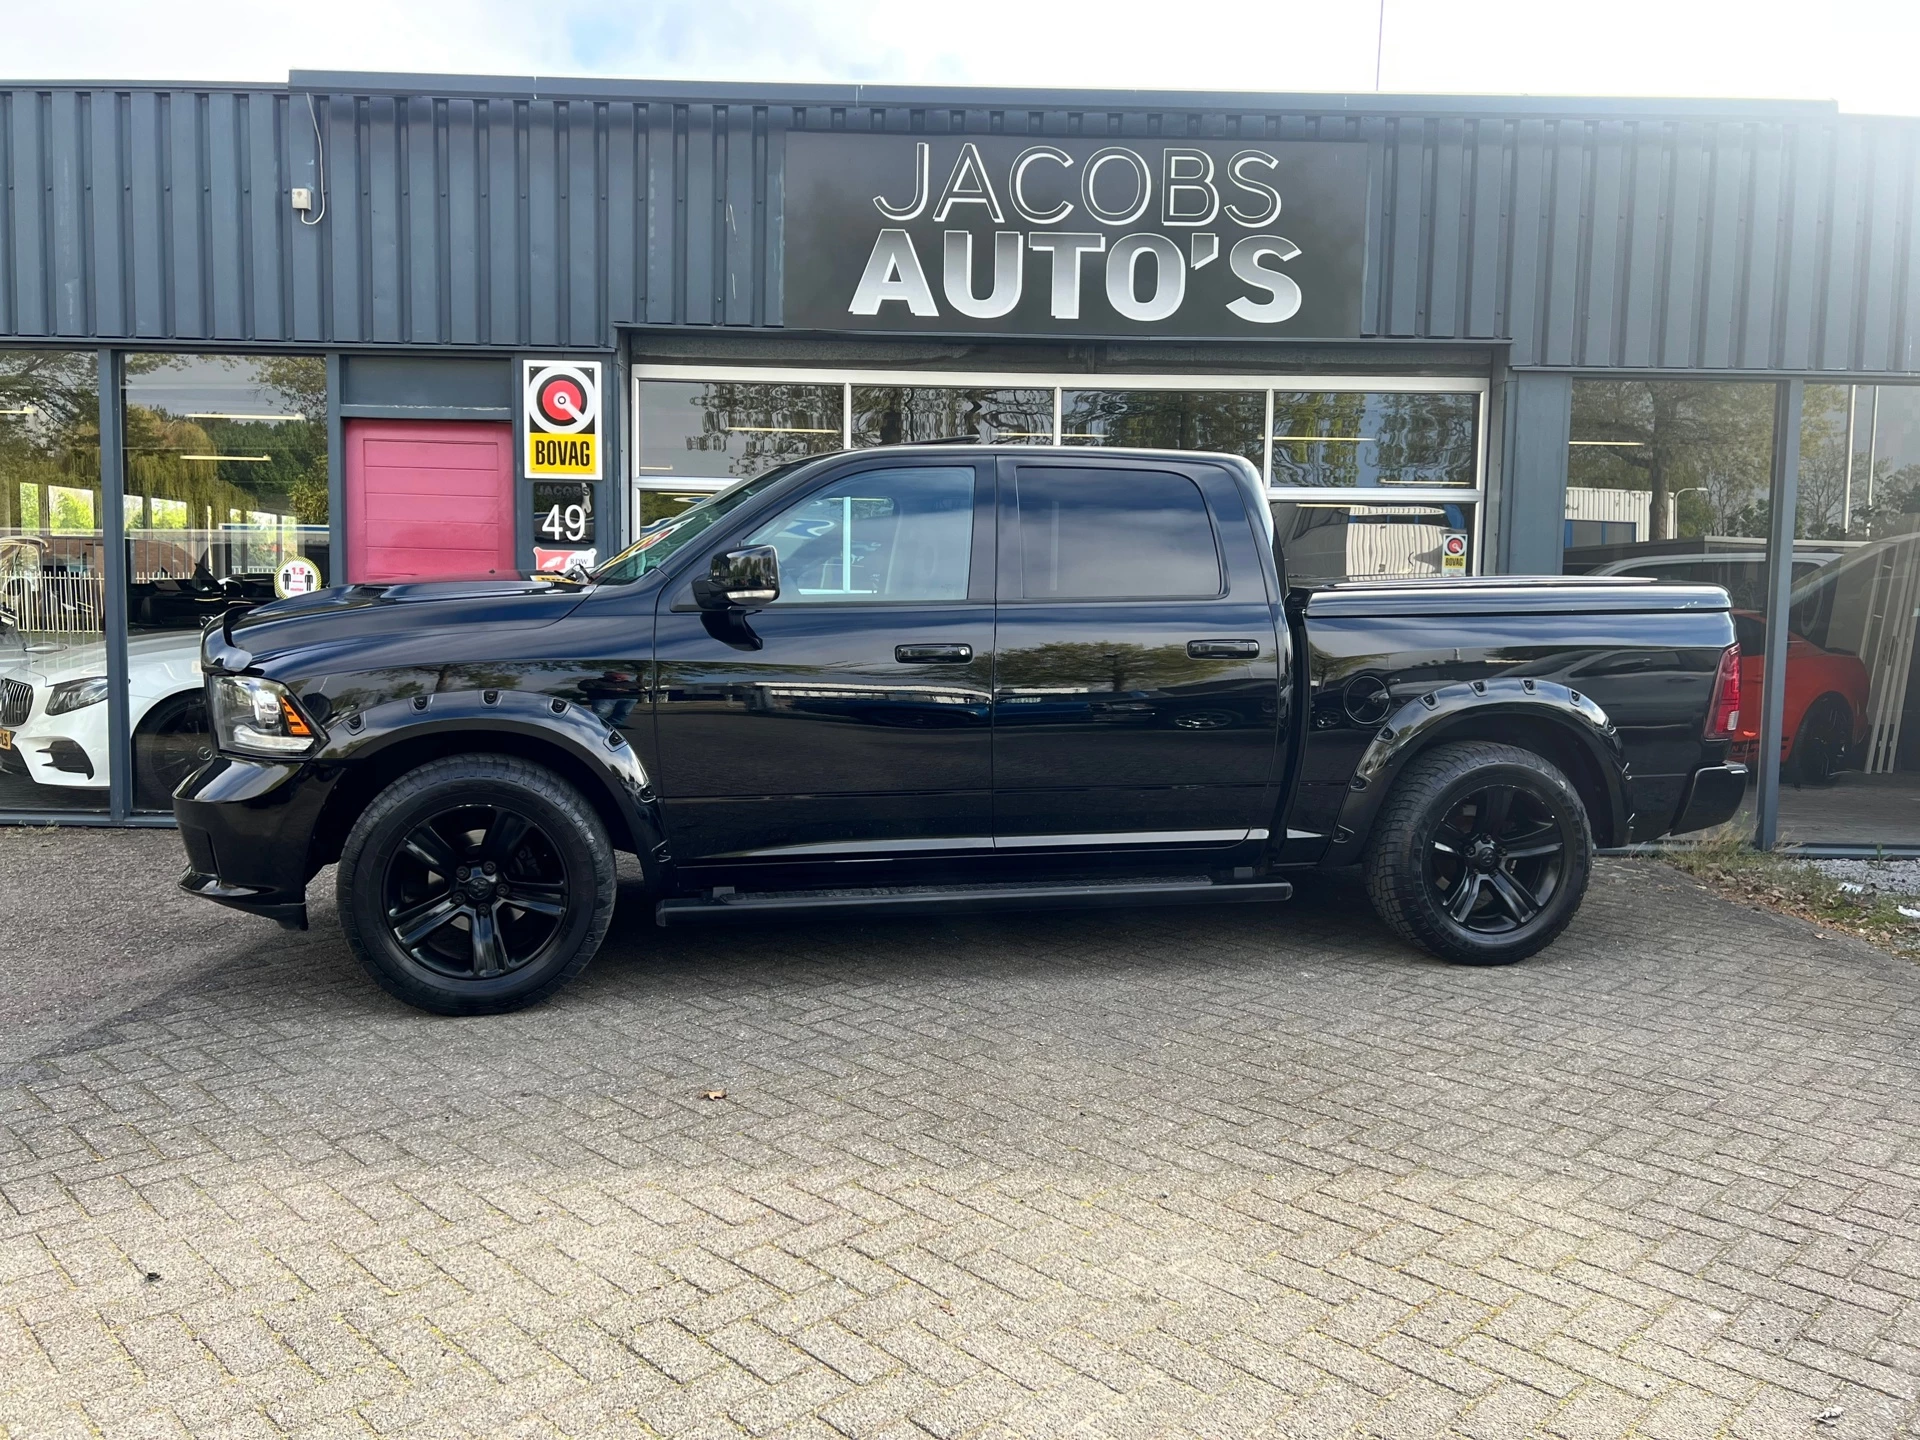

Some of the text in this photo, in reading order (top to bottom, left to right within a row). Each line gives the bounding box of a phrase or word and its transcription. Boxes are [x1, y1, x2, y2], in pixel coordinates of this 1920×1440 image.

[873, 142, 1281, 228] JACOBS
[848, 229, 1302, 323] AUTO'S
[535, 440, 590, 466] BOVAG
[542, 504, 585, 541] 49
[1445, 557, 1463, 567] BOVAG
